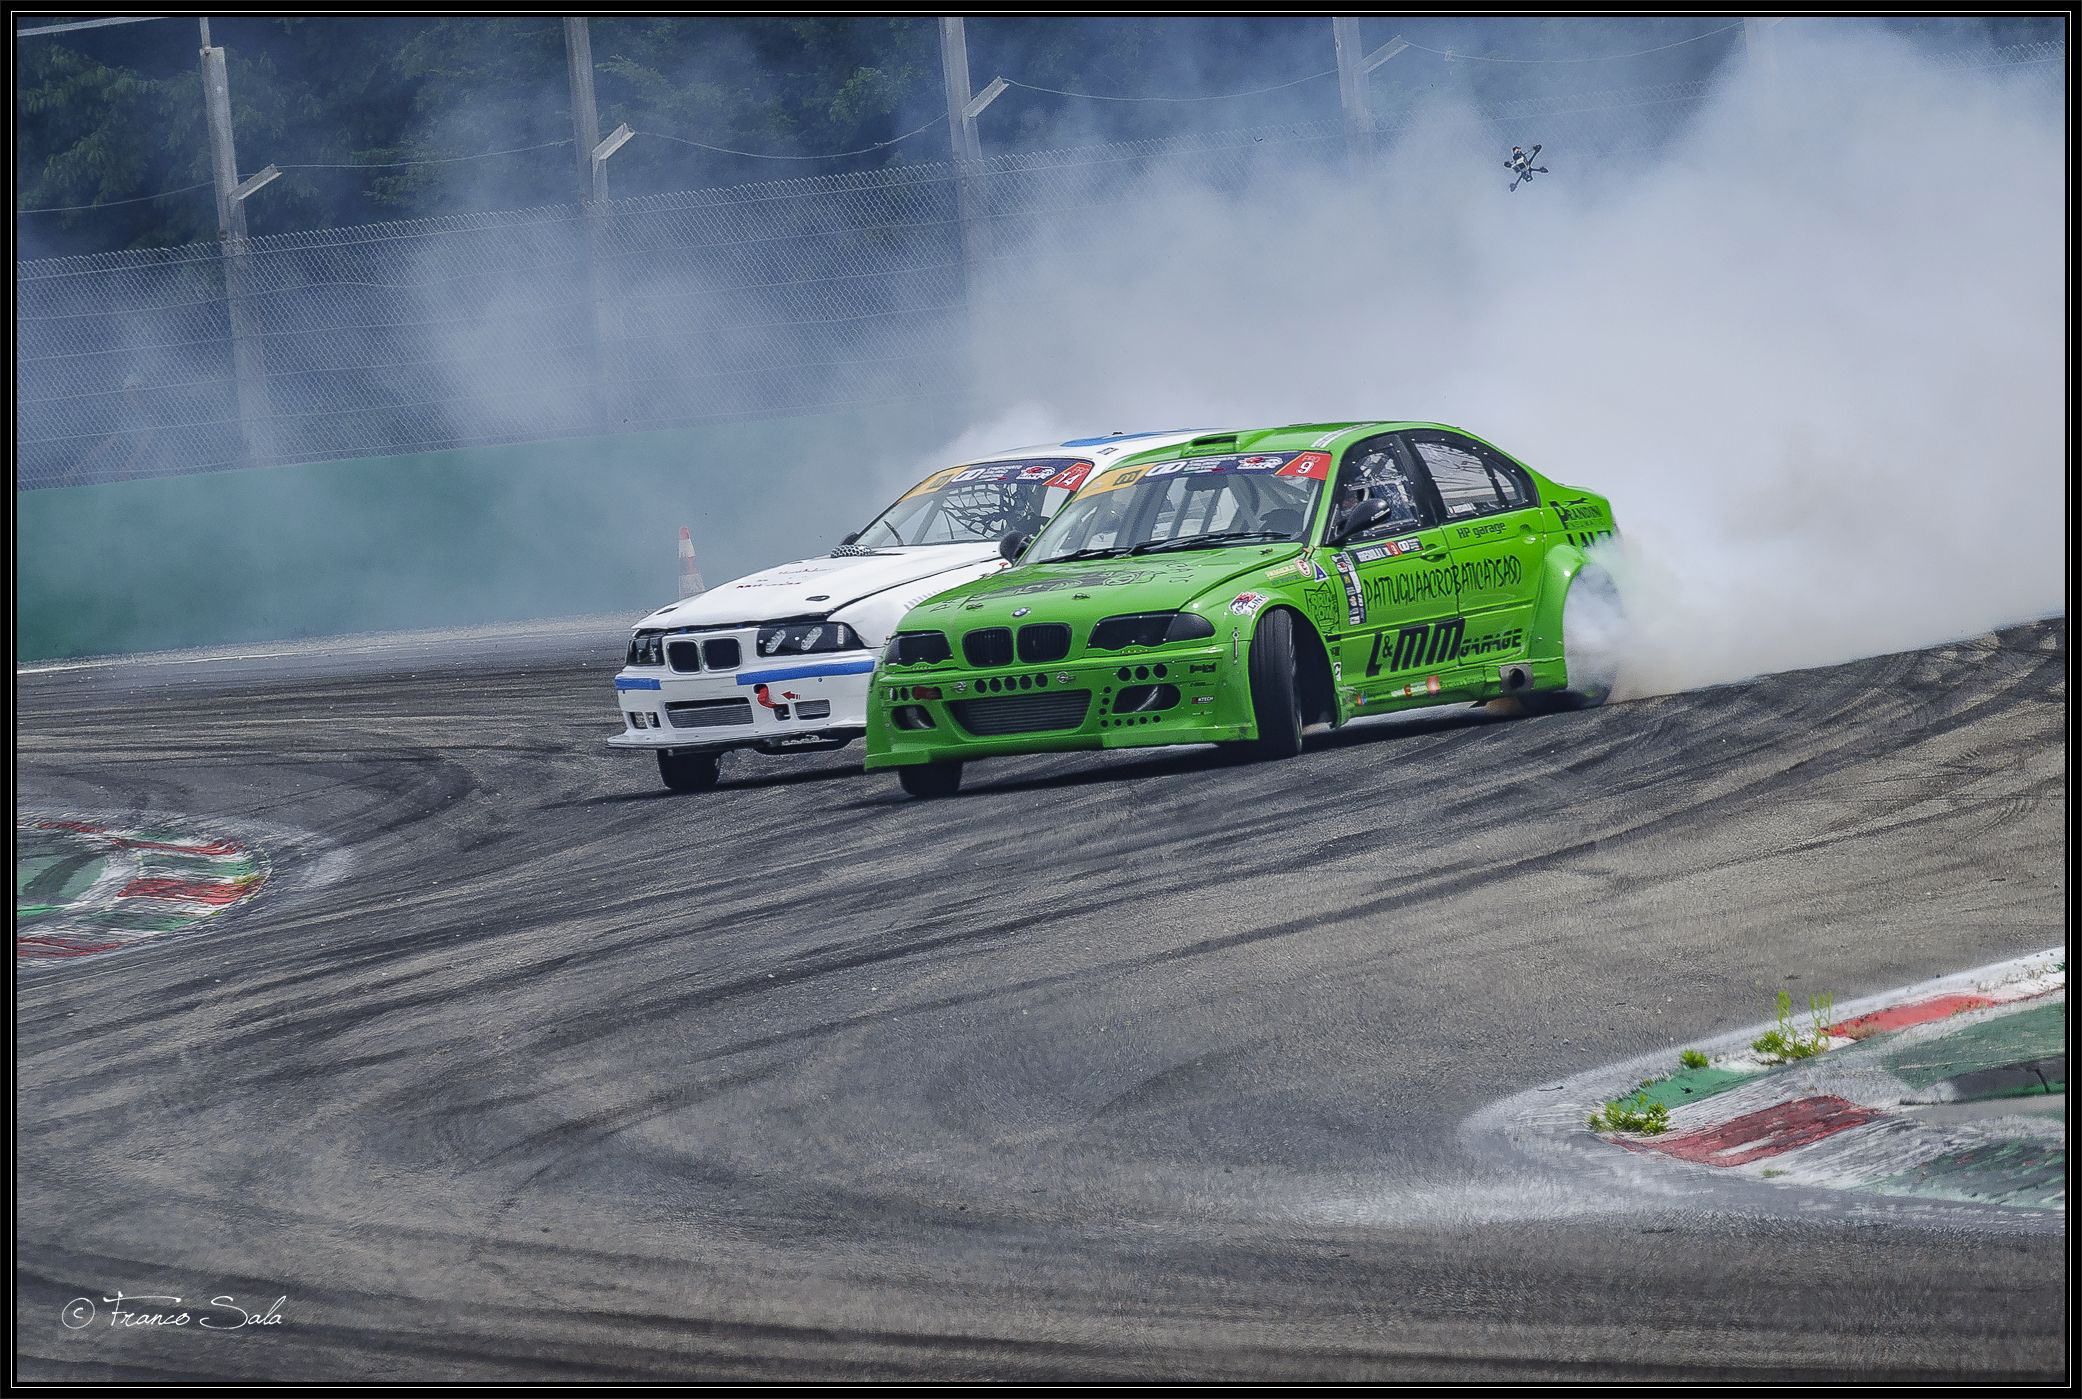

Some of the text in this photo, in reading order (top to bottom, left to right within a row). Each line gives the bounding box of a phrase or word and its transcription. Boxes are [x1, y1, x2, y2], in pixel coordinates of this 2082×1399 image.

[1296, 461, 1315, 475] 9
[1054, 471, 1080, 487] 14
[1456, 522, 1507, 539] HP garage
[1460, 628, 1523, 658] GARAGE
